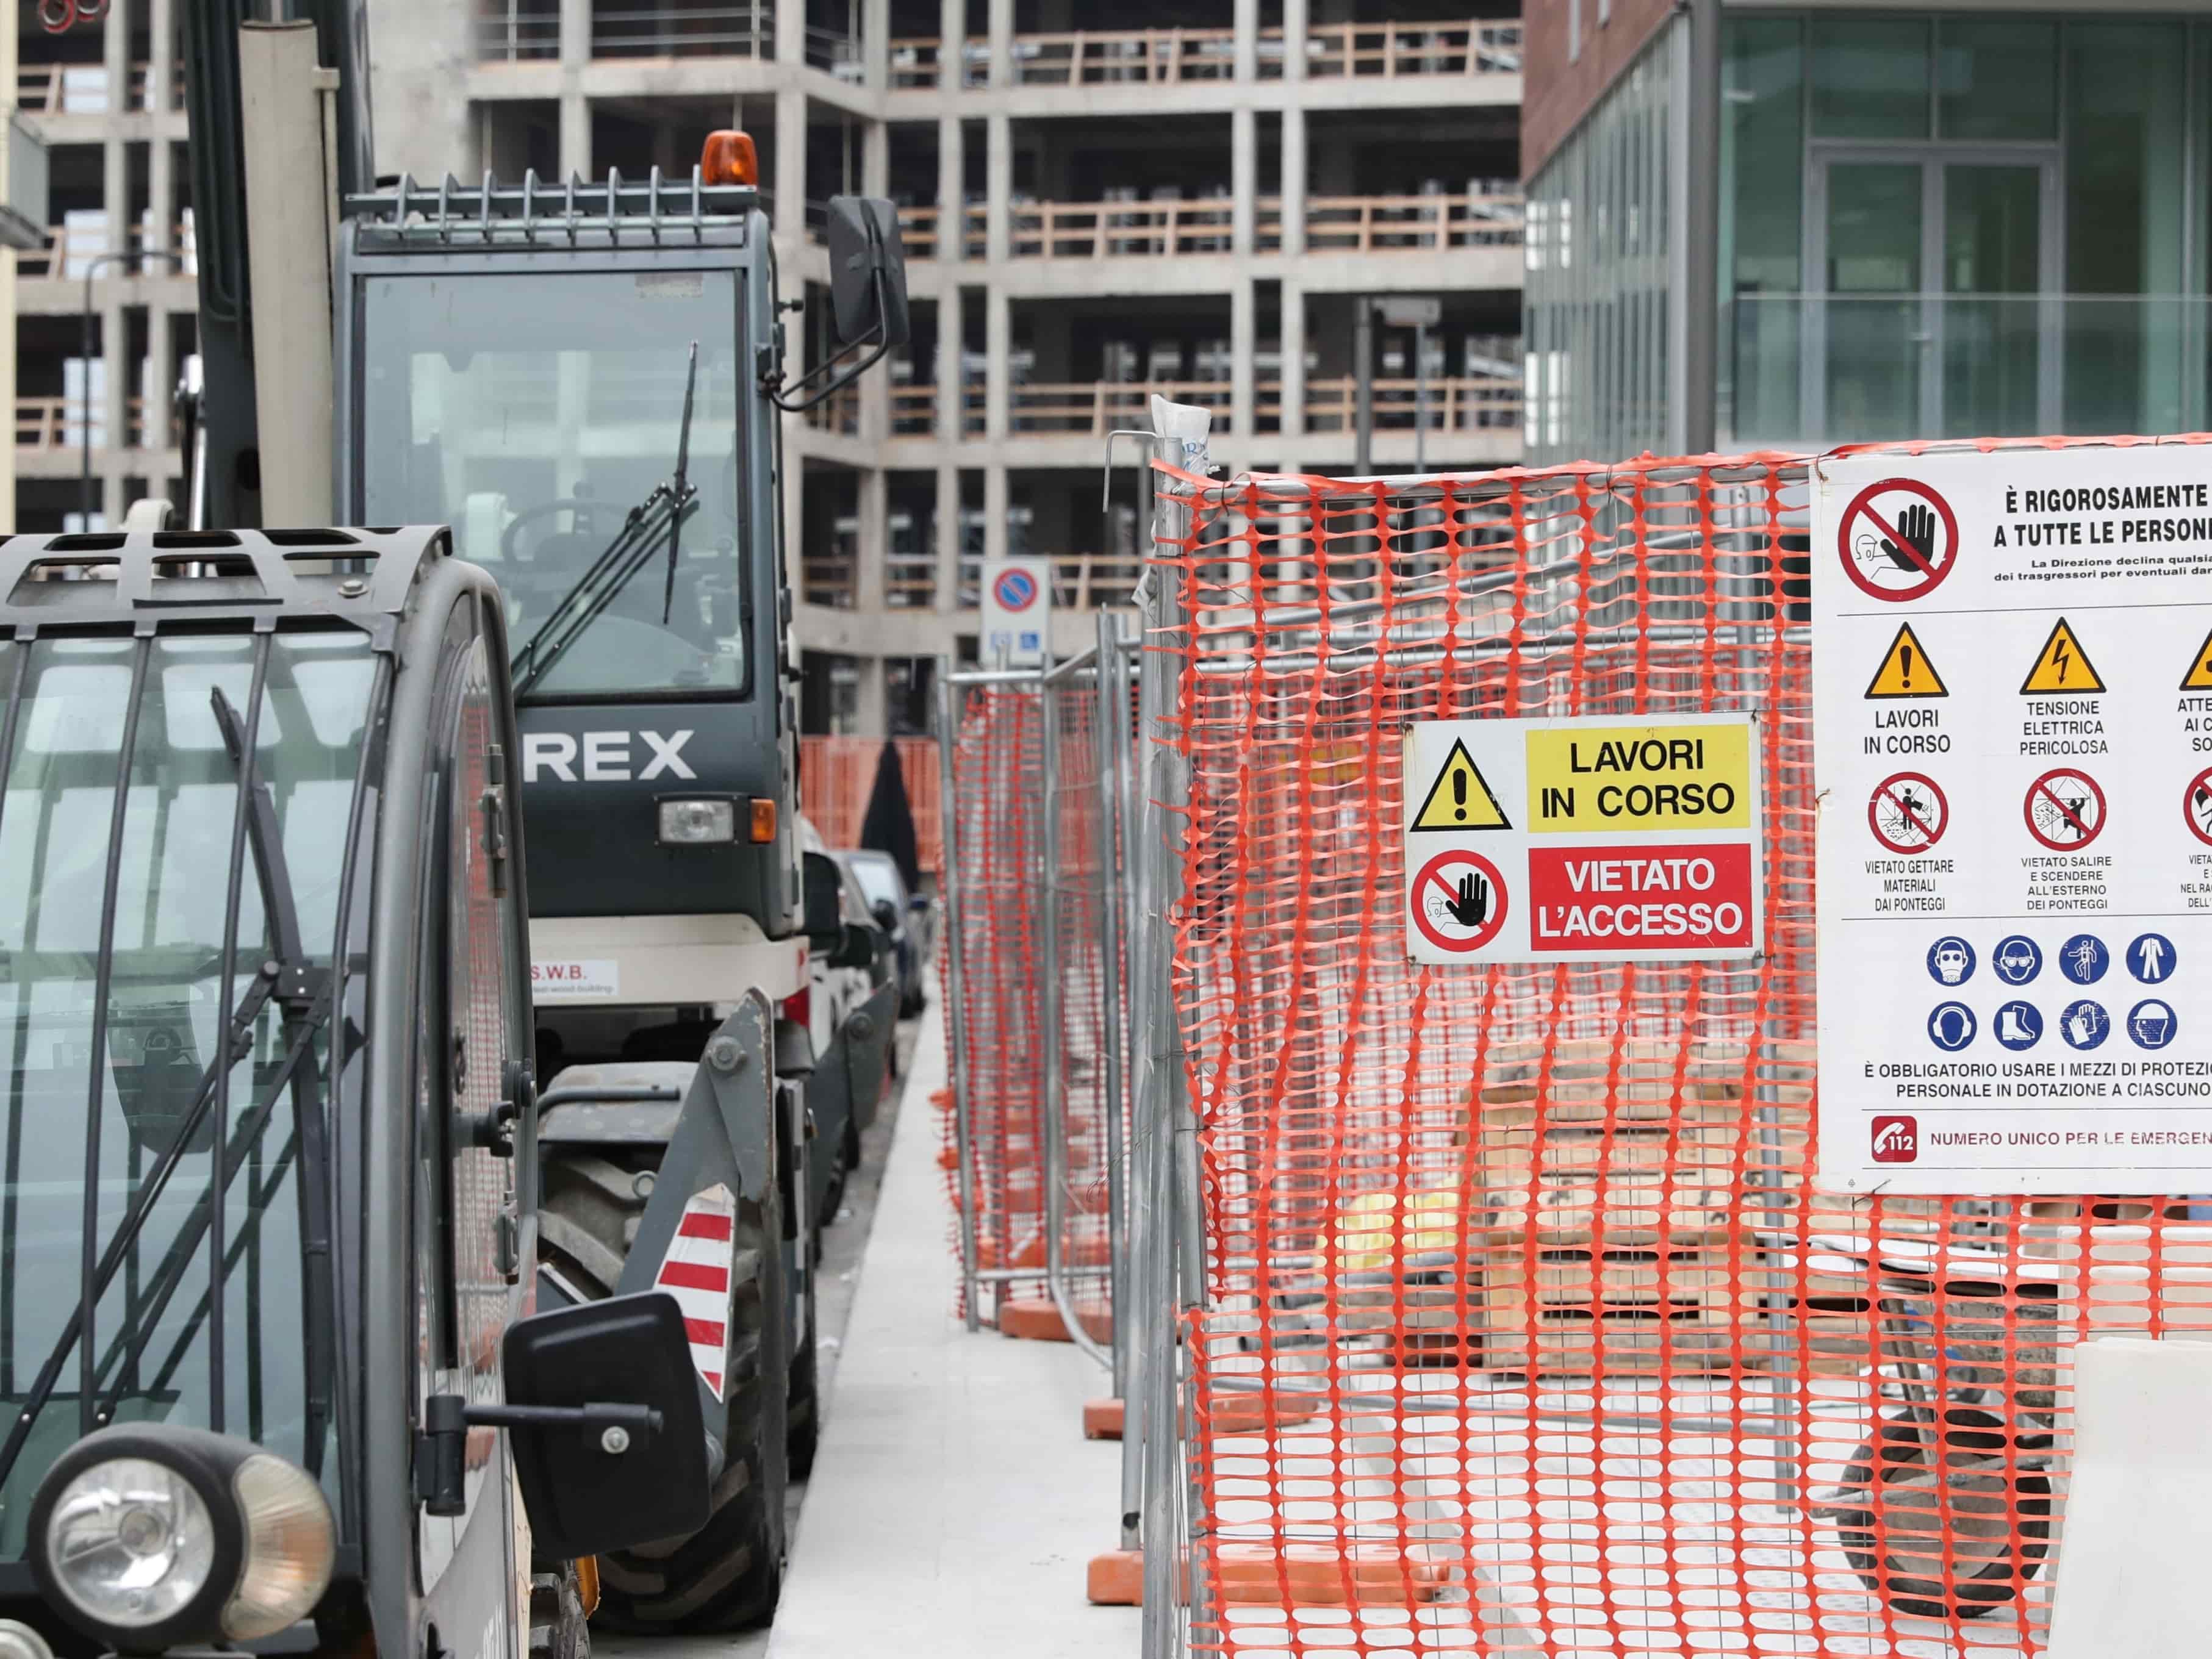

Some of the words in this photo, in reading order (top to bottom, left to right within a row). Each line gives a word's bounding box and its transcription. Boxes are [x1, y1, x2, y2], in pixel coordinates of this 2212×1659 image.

[2006, 485, 2018, 514] È
[2025, 484, 2208, 513] RIGOROSAMENTE
[1994, 525, 2007, 547] A
[2014, 522, 2082, 546] TUTTE
[2090, 521, 2114, 544] LE
[2122, 517, 2212, 543] PERSON
[2051, 558, 2112, 567] Direzione
[2116, 556, 2164, 565] declina
[1994, 572, 2013, 581] dei
[2018, 570, 2096, 581] trasgressori
[2100, 571, 2122, 579] per
[2126, 567, 2186, 577] eventuali
[2027, 700, 2099, 715] TENSIONE
[1875, 709, 1939, 729] LAVORI
[2185, 718, 2199, 731] AI
[2023, 720, 2104, 736] ELETTRICA
[1864, 736, 1881, 754] IN
[1886, 734, 1950, 754] CORSO
[2020, 740, 2108, 755] PERICOLOSA
[523, 728, 697, 783] REX
[1571, 739, 1704, 773] LAVORI
[1542, 787, 1575, 818] IN
[1598, 783, 1735, 817] CORSO
[1865, 860, 1905, 874] VIETATO
[1908, 859, 1954, 874] GETTARE
[2021, 857, 2067, 867] VIETATO
[2071, 856, 2112, 867] SALIRE
[2189, 855, 2212, 864] VIETA
[1565, 858, 1715, 893] VIETATO
[2030, 872, 2037, 881] E
[2041, 870, 2103, 881] SCENDERE
[1884, 879, 1936, 892] MATERIALI
[2028, 884, 2106, 896] ALL'ESTERNO
[2181, 883, 2197, 894] NEL
[2199, 883, 2212, 893] RA
[1875, 898, 1891, 911] DAI
[1894, 897, 1945, 911] PONTEGGI
[2027, 900, 2045, 910] DEI
[2049, 899, 2108, 910] PONTEGGI
[1539, 903, 1743, 937] L'ACCESSO
[1865, 1061, 1875, 1078] È
[1879, 1063, 1997, 1078] OBBLIGATORIO
[2002, 1063, 2056, 1077] USARE
[2061, 1063, 2064, 1077] I
[2070, 1062, 2116, 1077] MEZZI
[2121, 1062, 2136, 1076] DI
[2142, 1062, 2212, 1076] PROTEZI
[1897, 1084, 1992, 1098] PERSONALE
[1997, 1084, 2011, 1097] IN
[2017, 1083, 2106, 1097] DOTAZIONE
[2111, 1083, 2122, 1096] A
[2127, 1082, 2211, 1097] CIASCUNO
[1889, 1136, 1913, 1150] 112
[1931, 1132, 2002, 1145] NUMERO
[2008, 1132, 2060, 1145] UNICO
[2066, 1132, 2098, 1145] PER
[2104, 1132, 2124, 1144] LE
